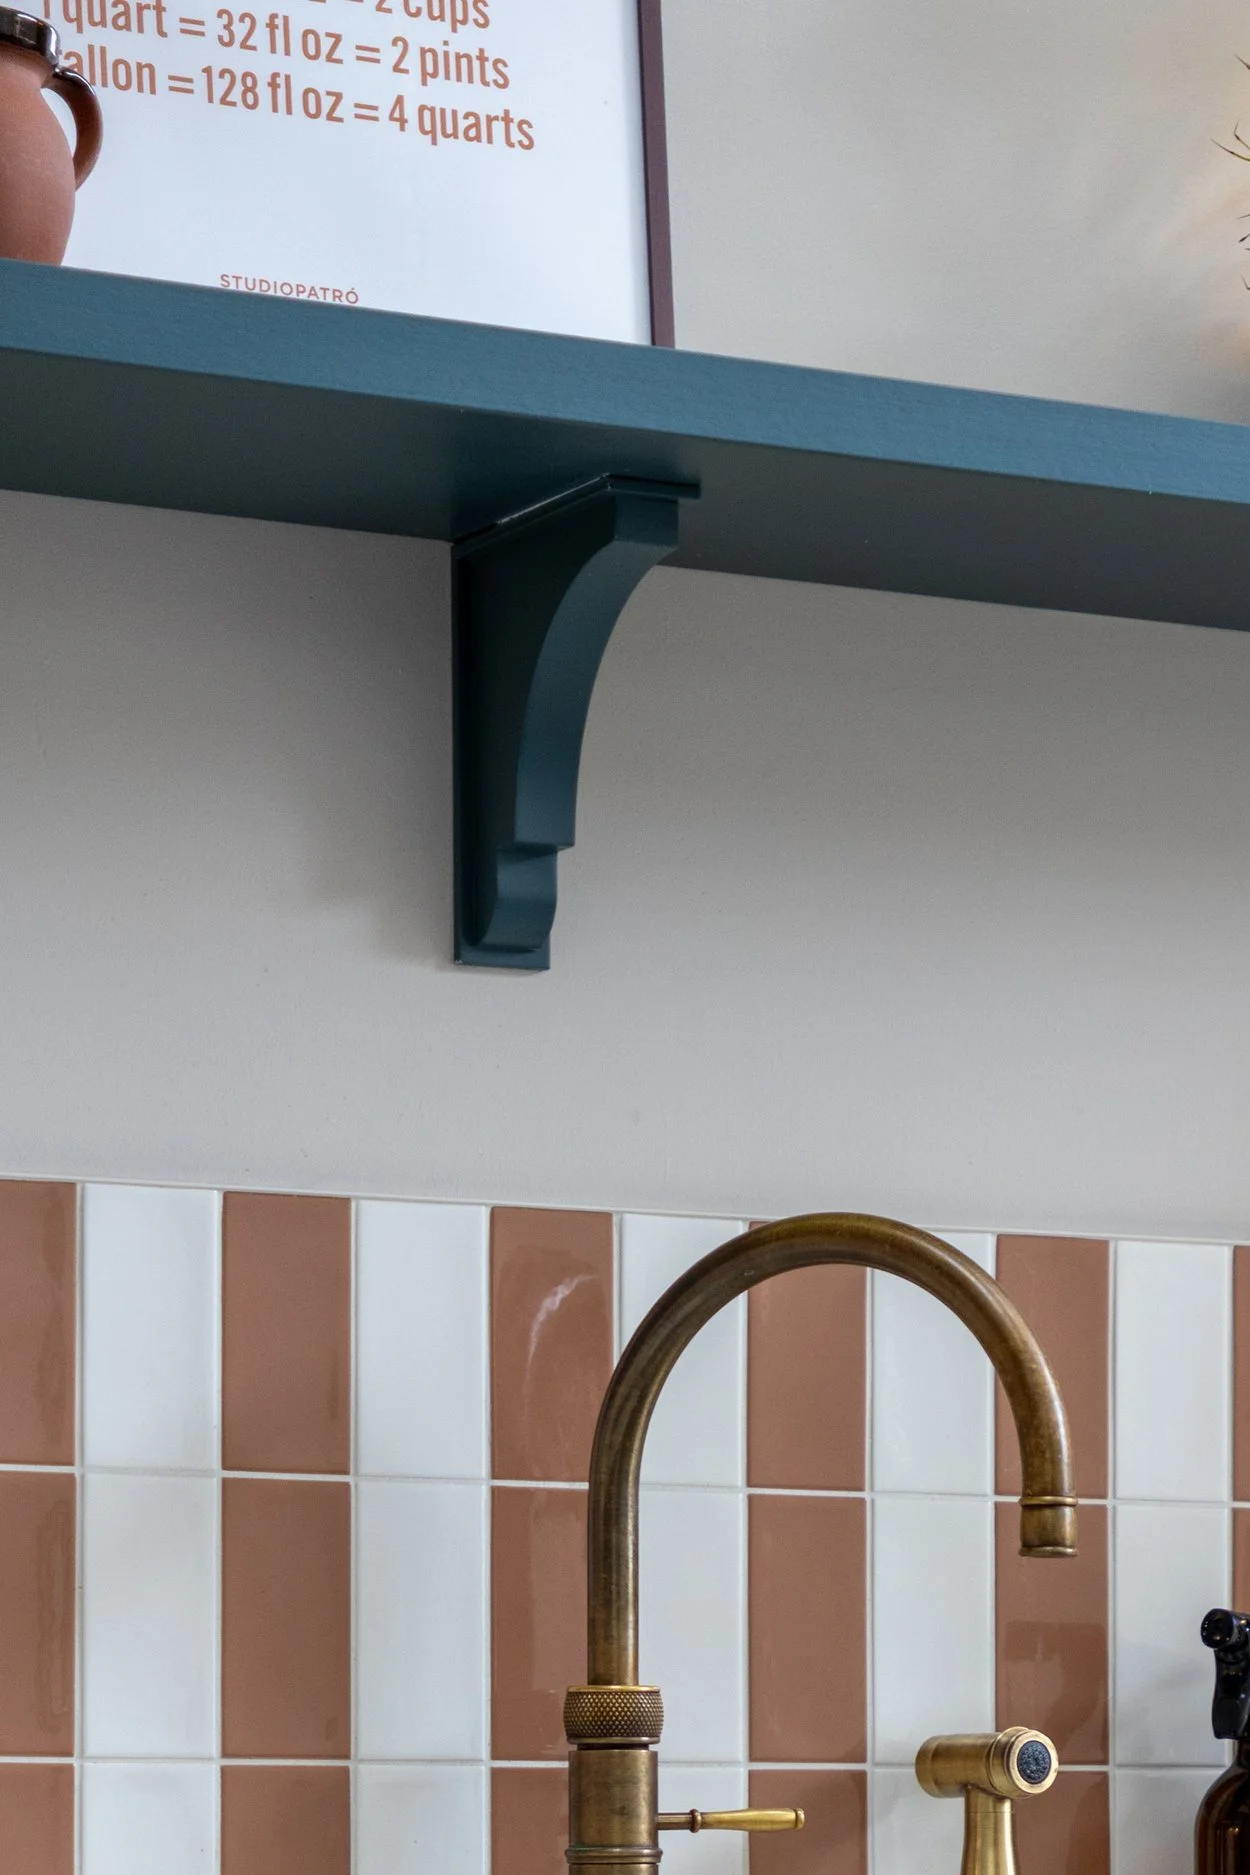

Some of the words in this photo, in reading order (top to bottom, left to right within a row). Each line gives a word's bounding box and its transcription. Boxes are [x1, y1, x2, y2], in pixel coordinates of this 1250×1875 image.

[62, 0, 168, 38] quart
[216, 8, 258, 54] 32
[265, 13, 291, 57] fl
[301, 28, 344, 65] oz
[391, 36, 410, 74] 2
[419, 40, 510, 90] pints
[403, 0, 491, 33] cups
[59, 43, 157, 96] allon
[201, 65, 260, 110] 128
[267, 72, 293, 116] fl
[302, 87, 345, 123] oz
[388, 94, 409, 132] 4
[417, 103, 535, 151] quarts
